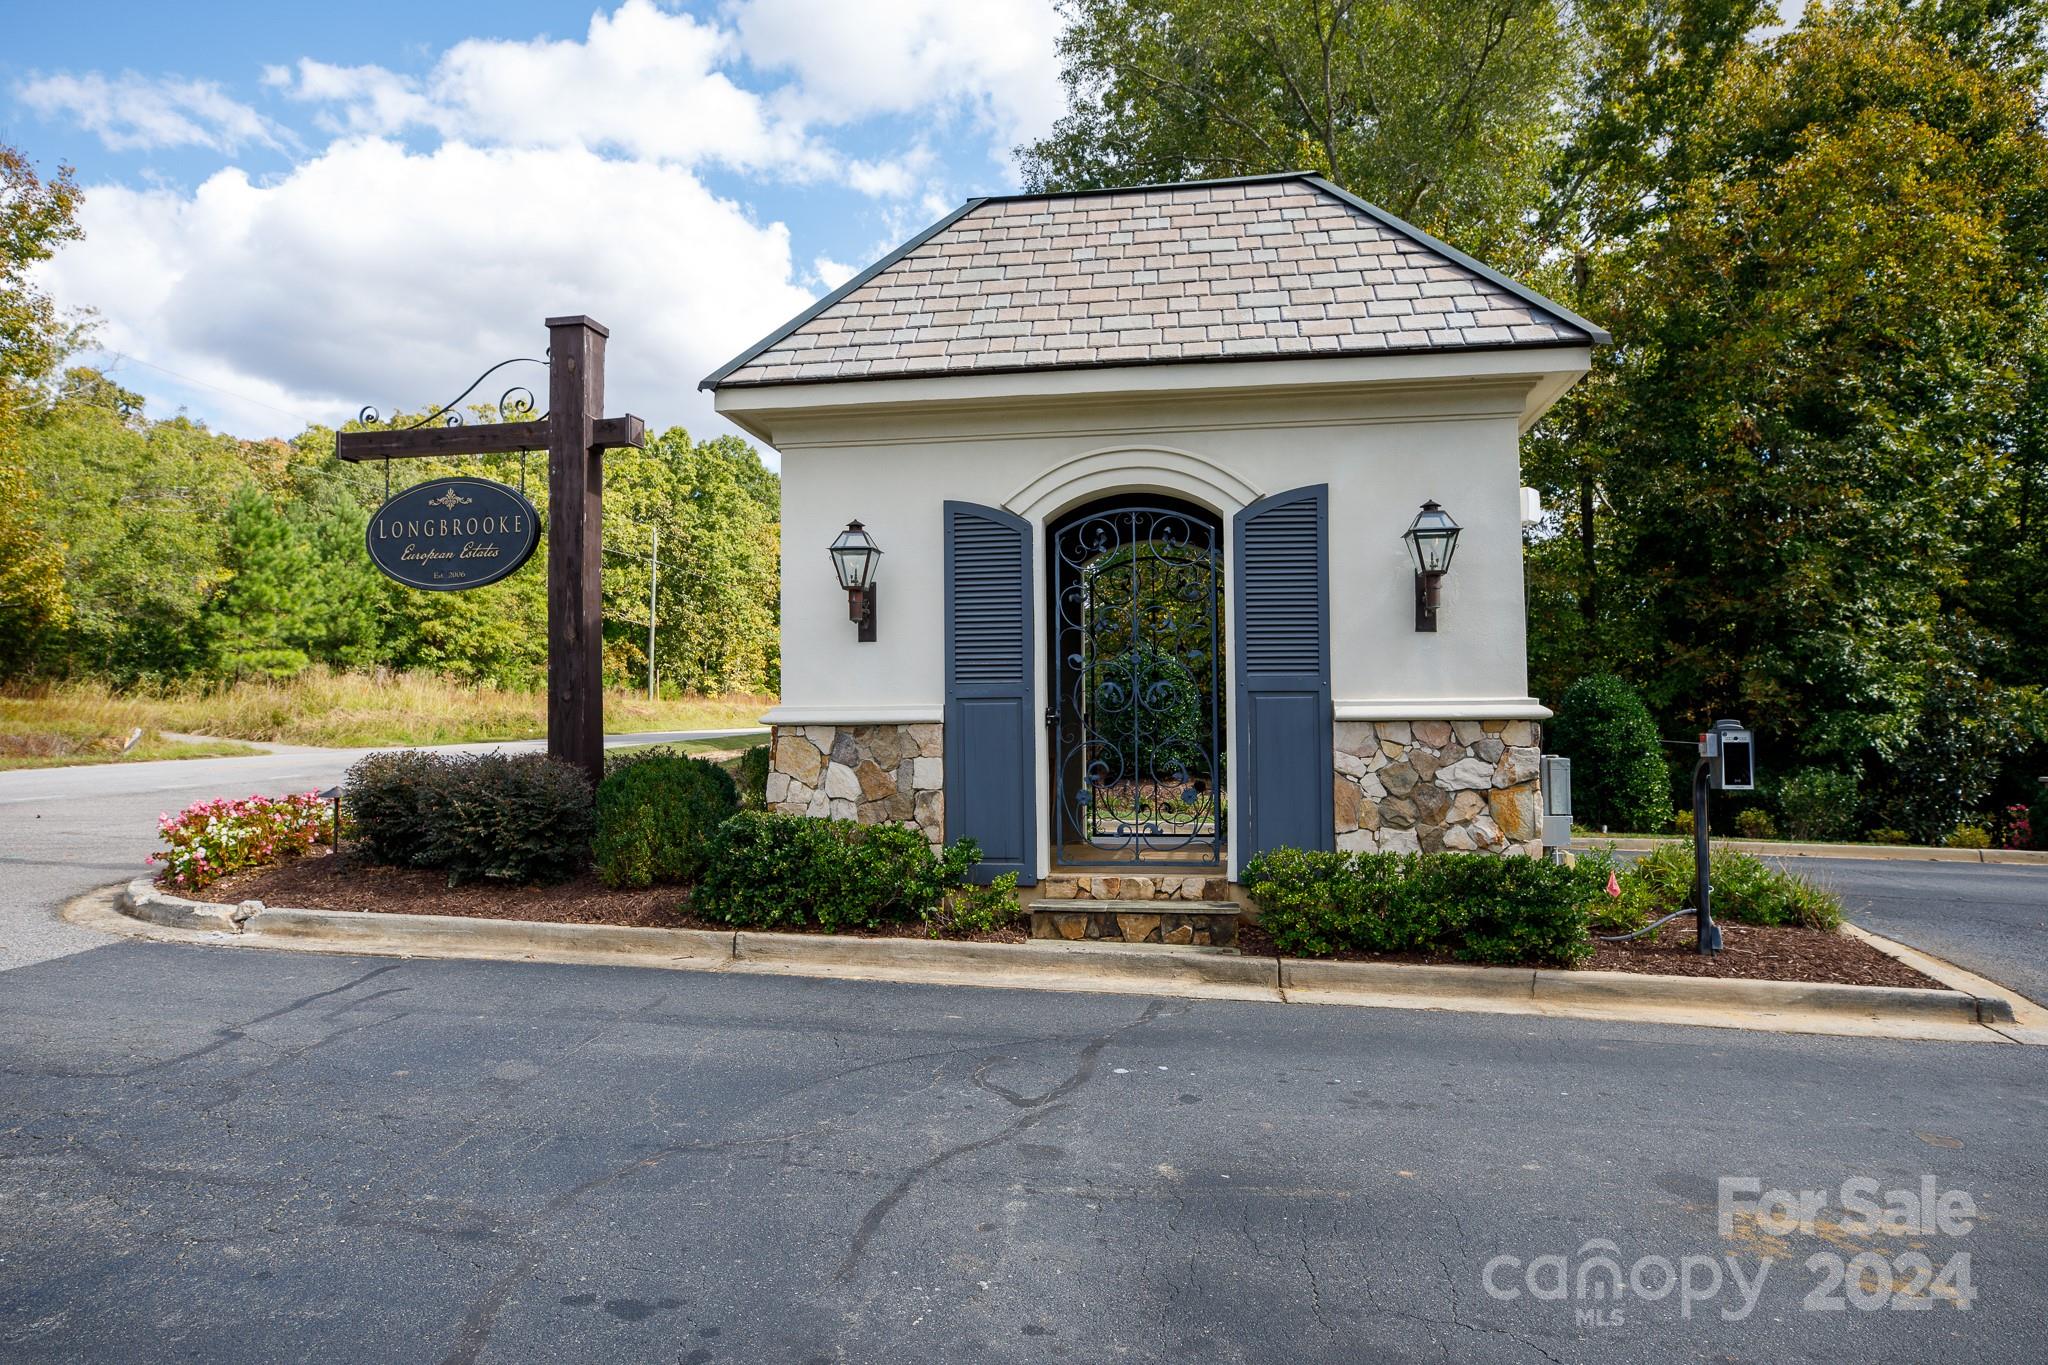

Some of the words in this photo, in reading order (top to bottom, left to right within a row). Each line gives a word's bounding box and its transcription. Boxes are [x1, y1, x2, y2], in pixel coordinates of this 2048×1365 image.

[379, 515, 522, 539] LONGBROOKE
[401, 543, 454, 566] European
[459, 541, 500, 560] Estates
[448, 571, 466, 579] 2006
